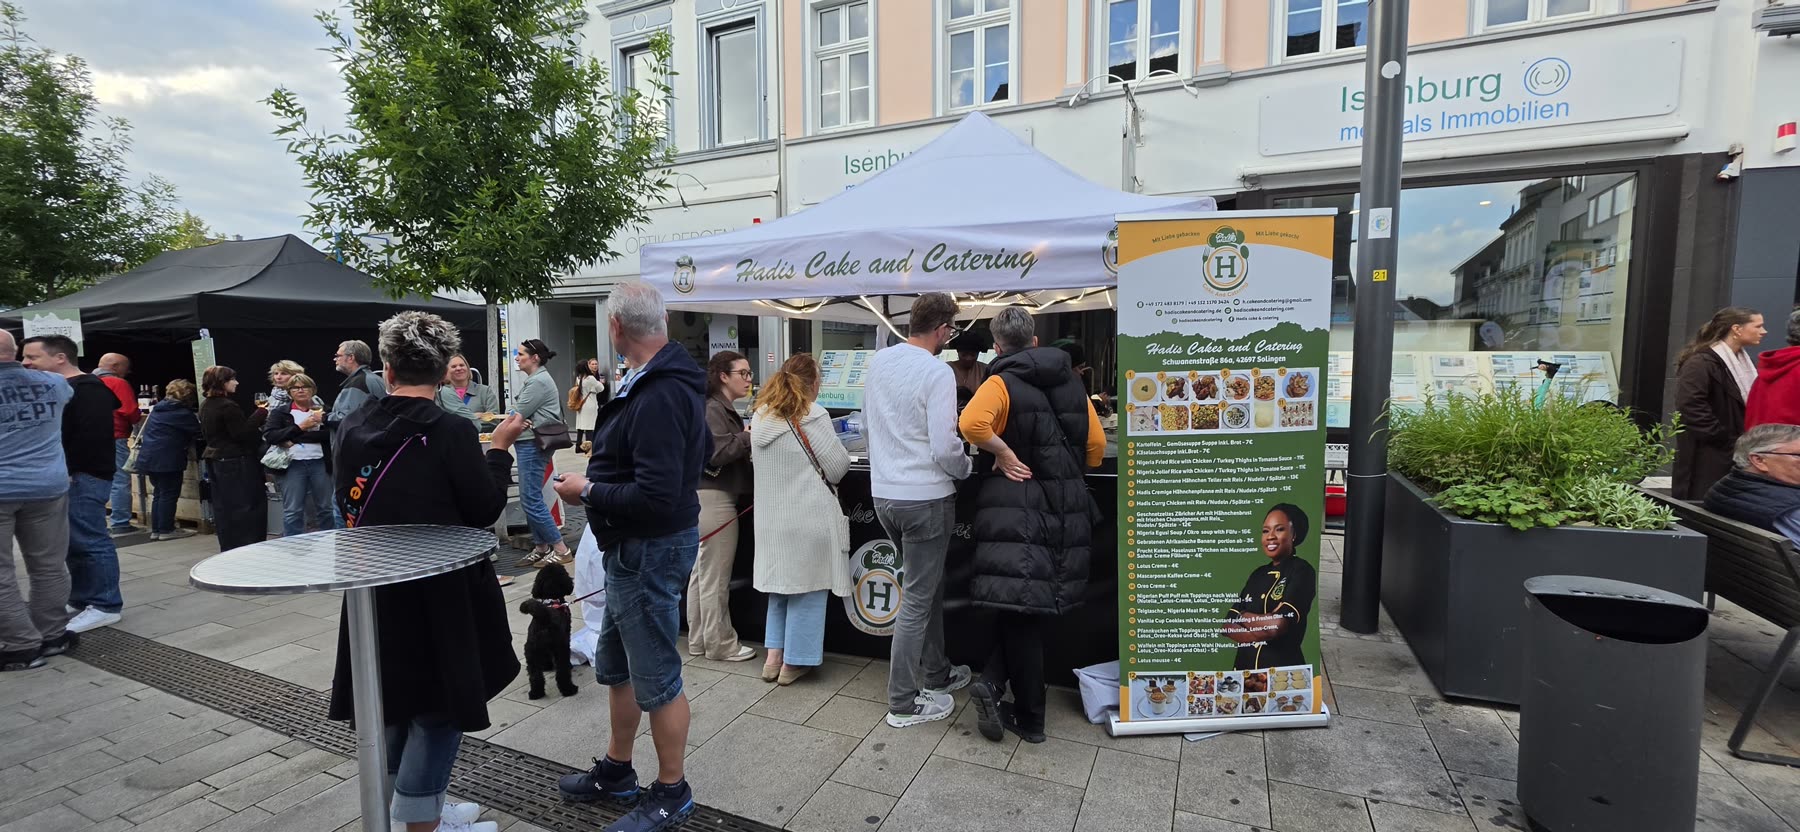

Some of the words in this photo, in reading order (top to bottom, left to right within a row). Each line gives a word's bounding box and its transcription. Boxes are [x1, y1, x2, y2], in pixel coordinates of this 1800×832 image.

[1342, 73, 1501, 112] Isnburg
[1441, 100, 1569, 130] Immobilien
[845, 149, 912, 174] Isenb
[1176, 231, 1200, 239] gebacken
[736, 258, 797, 283] Hadis
[804, 250, 862, 279] Cake
[868, 248, 914, 274] and
[921, 242, 1039, 280] Catering
[1214, 255, 1237, 278] H
[1374, 271, 1386, 280] 21
[1146, 342, 1184, 356] Hadis
[1187, 340, 1224, 356] Cakes
[1227, 341, 1252, 353] and
[1254, 339, 1304, 354] Catering
[1162, 356, 1219, 366] Schwanenstraße
[1219, 356, 1235, 365] 86a,
[1236, 355, 1256, 364] 42697
[1257, 355, 1286, 365] Solingen
[818, 392, 845, 400] senburg
[848, 503, 875, 523] ke
[866, 580, 893, 612] H
